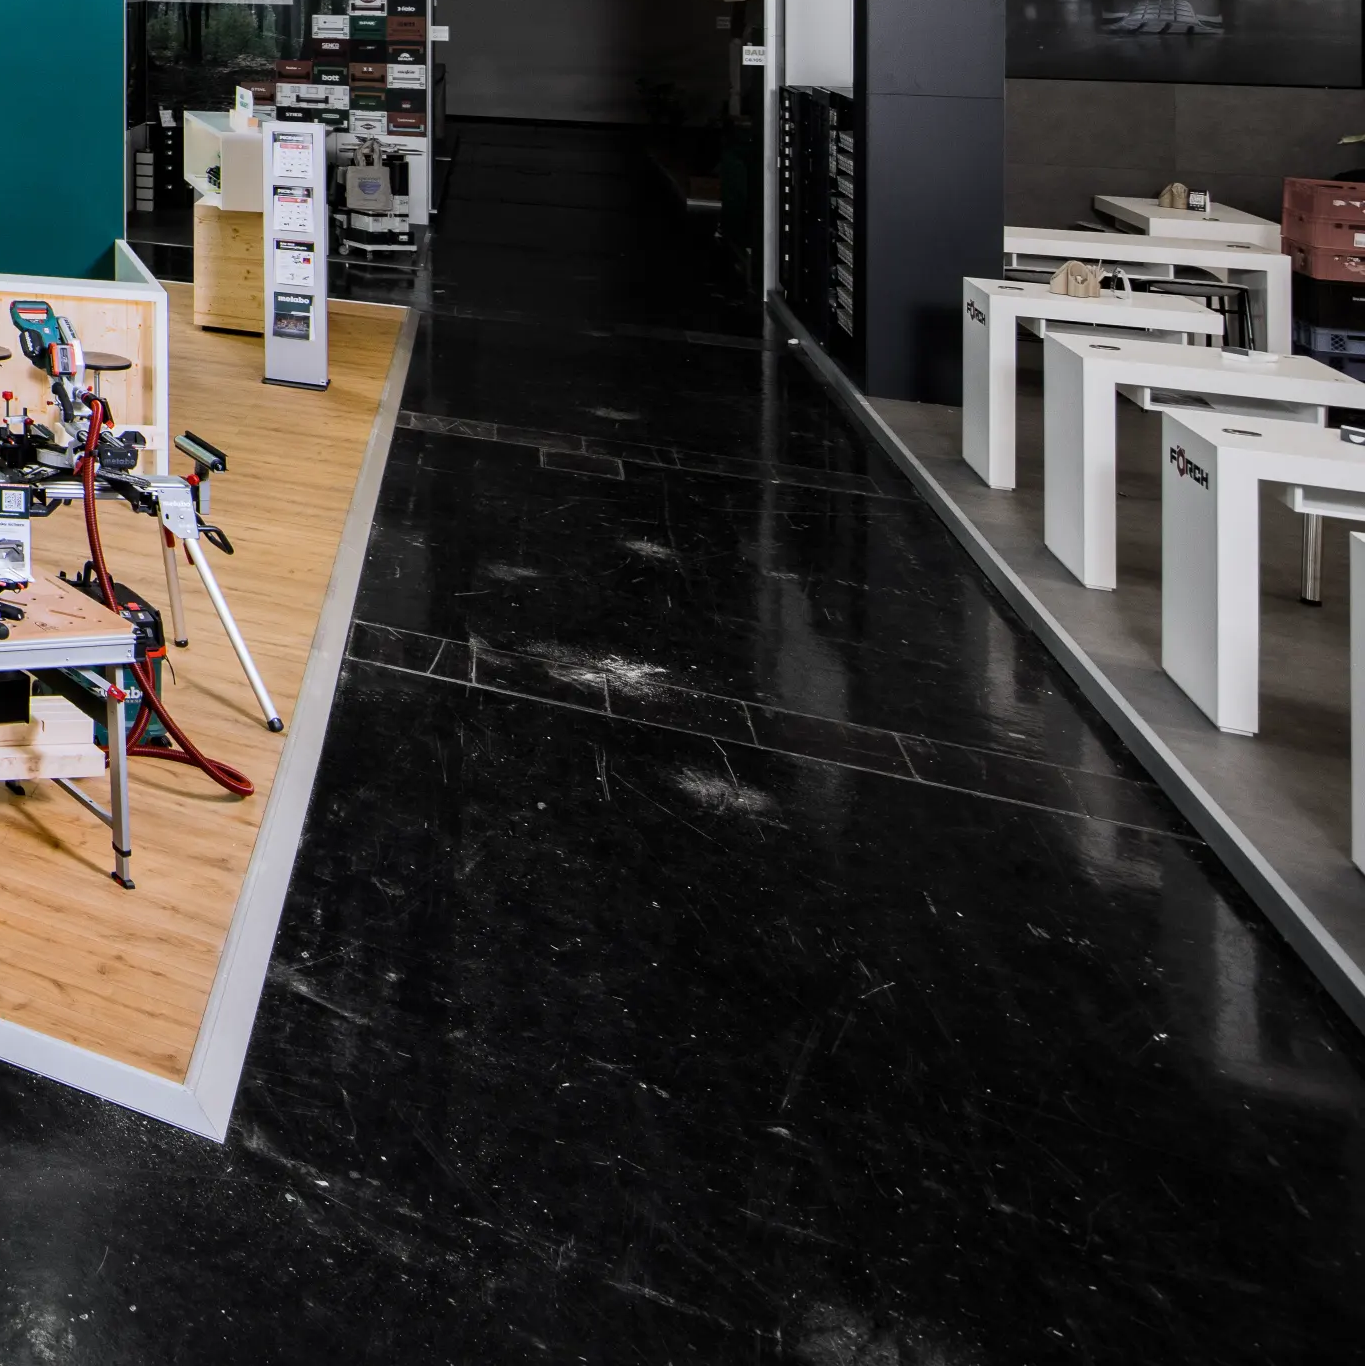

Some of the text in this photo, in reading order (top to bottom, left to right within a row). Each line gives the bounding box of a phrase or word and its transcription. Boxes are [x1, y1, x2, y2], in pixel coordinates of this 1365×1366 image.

[322, 74, 340, 82] bott
[277, 296, 310, 305] metabo
[966, 300, 987, 327] FÖRCH
[103, 457, 135, 466] metabo
[1169, 445, 1210, 490] FÖRCH
